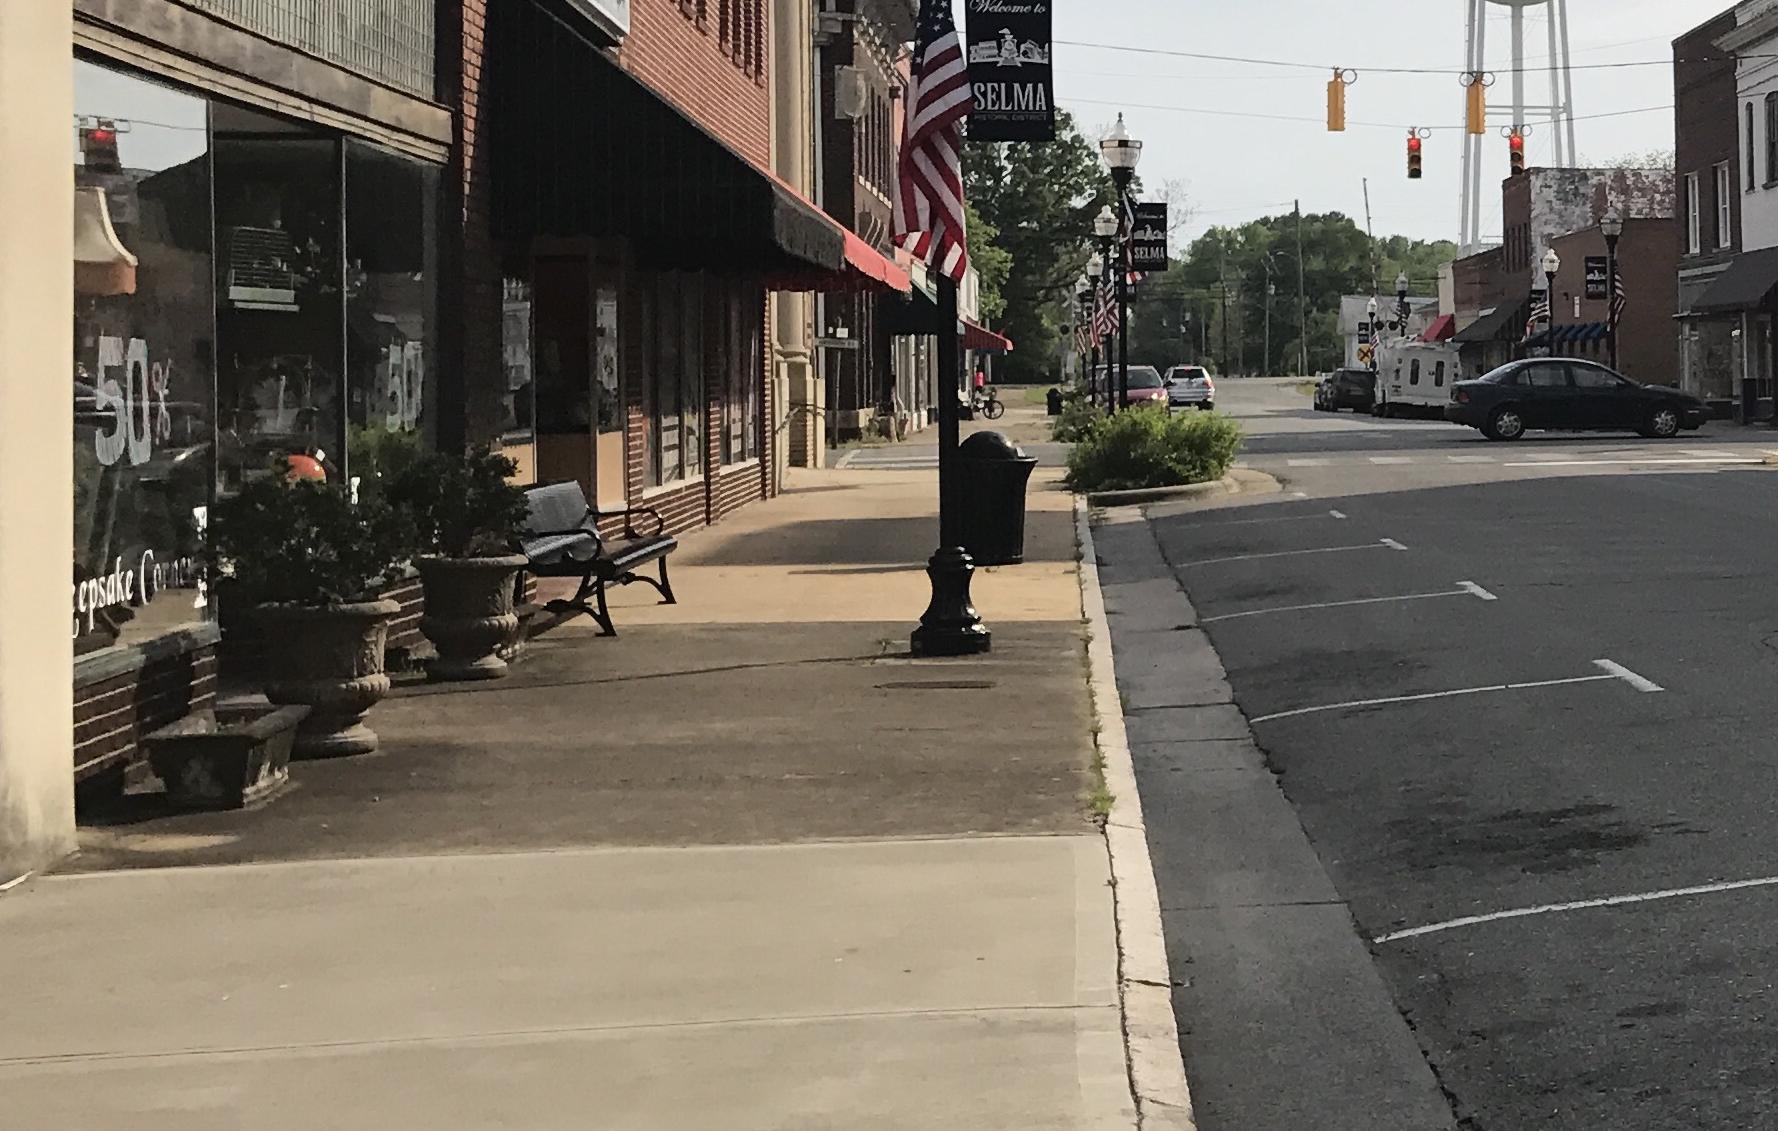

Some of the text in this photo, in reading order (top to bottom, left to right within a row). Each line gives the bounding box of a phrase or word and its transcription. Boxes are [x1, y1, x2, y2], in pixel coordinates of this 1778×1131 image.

[1033, 2, 1046, 14] to
[973, 82, 1047, 111] SELMA
[1134, 246, 1165, 260] SELMA
[73, 555, 134, 638] epsake
